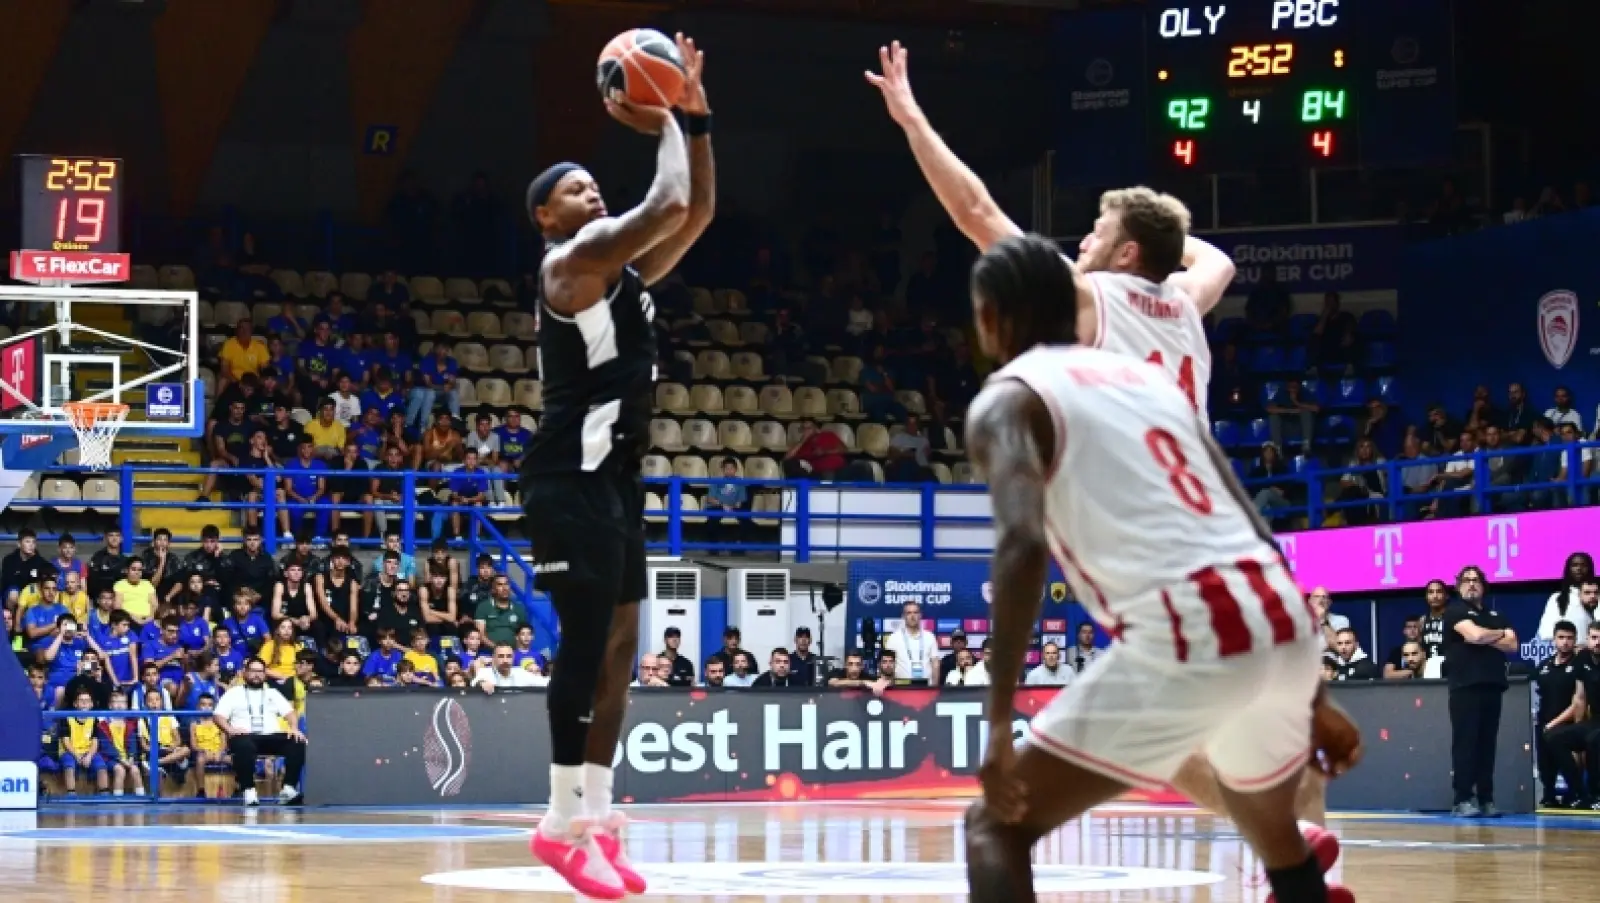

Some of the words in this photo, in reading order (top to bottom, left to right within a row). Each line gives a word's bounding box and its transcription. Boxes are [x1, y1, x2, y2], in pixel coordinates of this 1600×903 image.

[1160, 5, 1226, 38] OLY
[1271, 0, 1339, 30] PBC
[1228, 43, 1294, 77] 2:52
[1168, 98, 1209, 129] 92
[1243, 100, 1260, 124] 4
[1302, 90, 1345, 122] 84
[1174, 139, 1194, 165] 4
[1312, 131, 1332, 156] 4
[46, 159, 116, 191] 2:52
[56, 197, 105, 242] 19
[51, 256, 121, 276] FlexCar
[1309, 262, 1353, 281] CUP
[1144, 426, 1214, 516] 8
[1374, 527, 1403, 584] T
[1488, 517, 1519, 578] T
[926, 594, 951, 604] CUP
[611, 708, 739, 774] est
[763, 699, 918, 771] Hair
